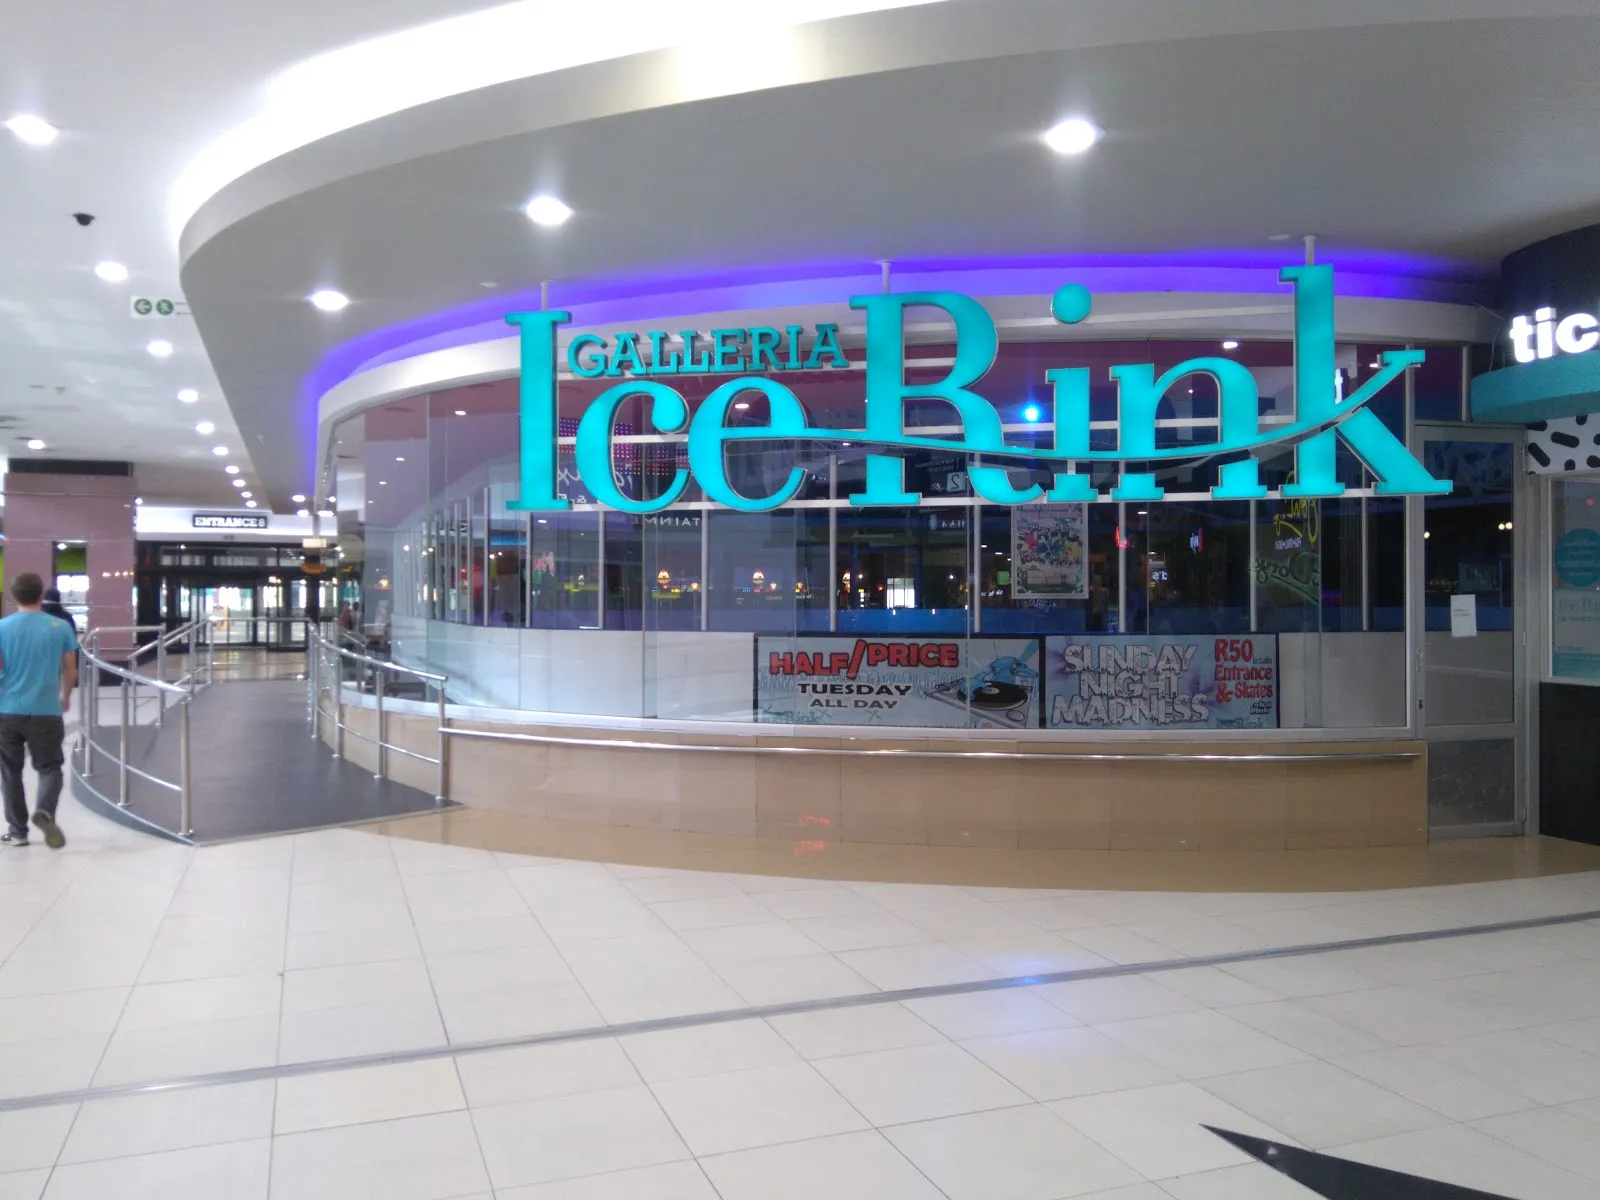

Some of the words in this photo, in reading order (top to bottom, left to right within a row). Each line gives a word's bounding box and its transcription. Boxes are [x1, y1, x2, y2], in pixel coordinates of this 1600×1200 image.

[567, 323, 848, 378] GALLERIA
[505, 311, 808, 513] Ice
[849, 263, 1453, 507] Rink
[194, 516, 257, 528] ENTRANCE
[1064, 644, 1198, 675] SUNDAY
[1214, 638, 1254, 662] R50
[1214, 664, 1273, 681] Entrance
[797, 682, 912, 696] TUESDAY
[1079, 671, 1183, 699] NIGHT
[1215, 682, 1234, 703] &
[1234, 681, 1274, 699] Skates
[810, 698, 848, 708] ALL
[853, 699, 898, 709] DAY
[1051, 693, 1210, 725] MADNESS
